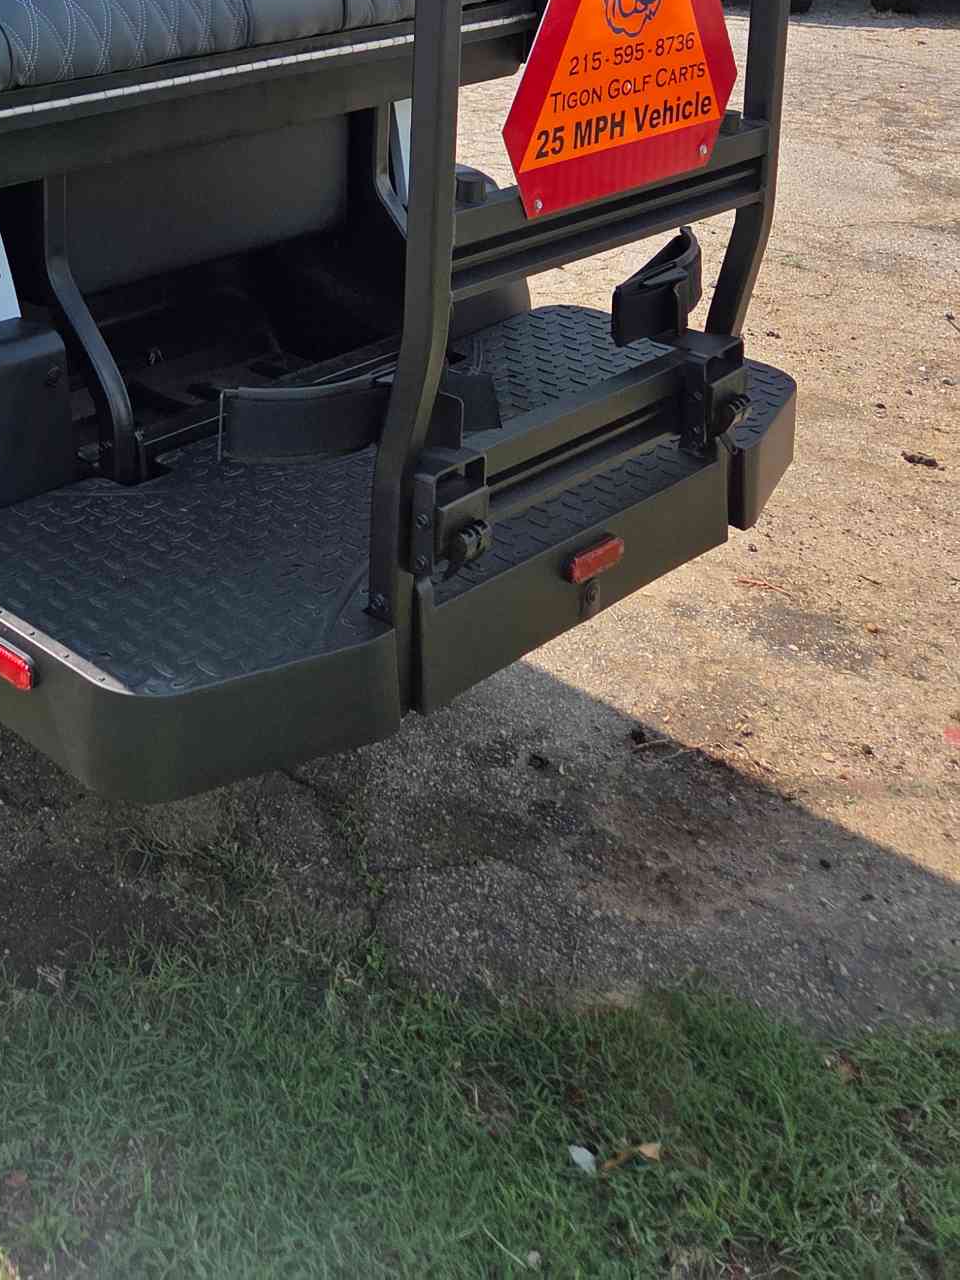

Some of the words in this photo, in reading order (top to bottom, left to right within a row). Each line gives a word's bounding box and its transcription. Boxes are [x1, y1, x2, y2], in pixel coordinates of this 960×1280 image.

[551, 85, 602, 113] TIGON
[607, 75, 651, 99] GOLF
[655, 62, 705, 87] CARTS
[535, 126, 565, 160] 25
[573, 110, 625, 150] MPH
[634, 91, 712, 133] Vehicle
